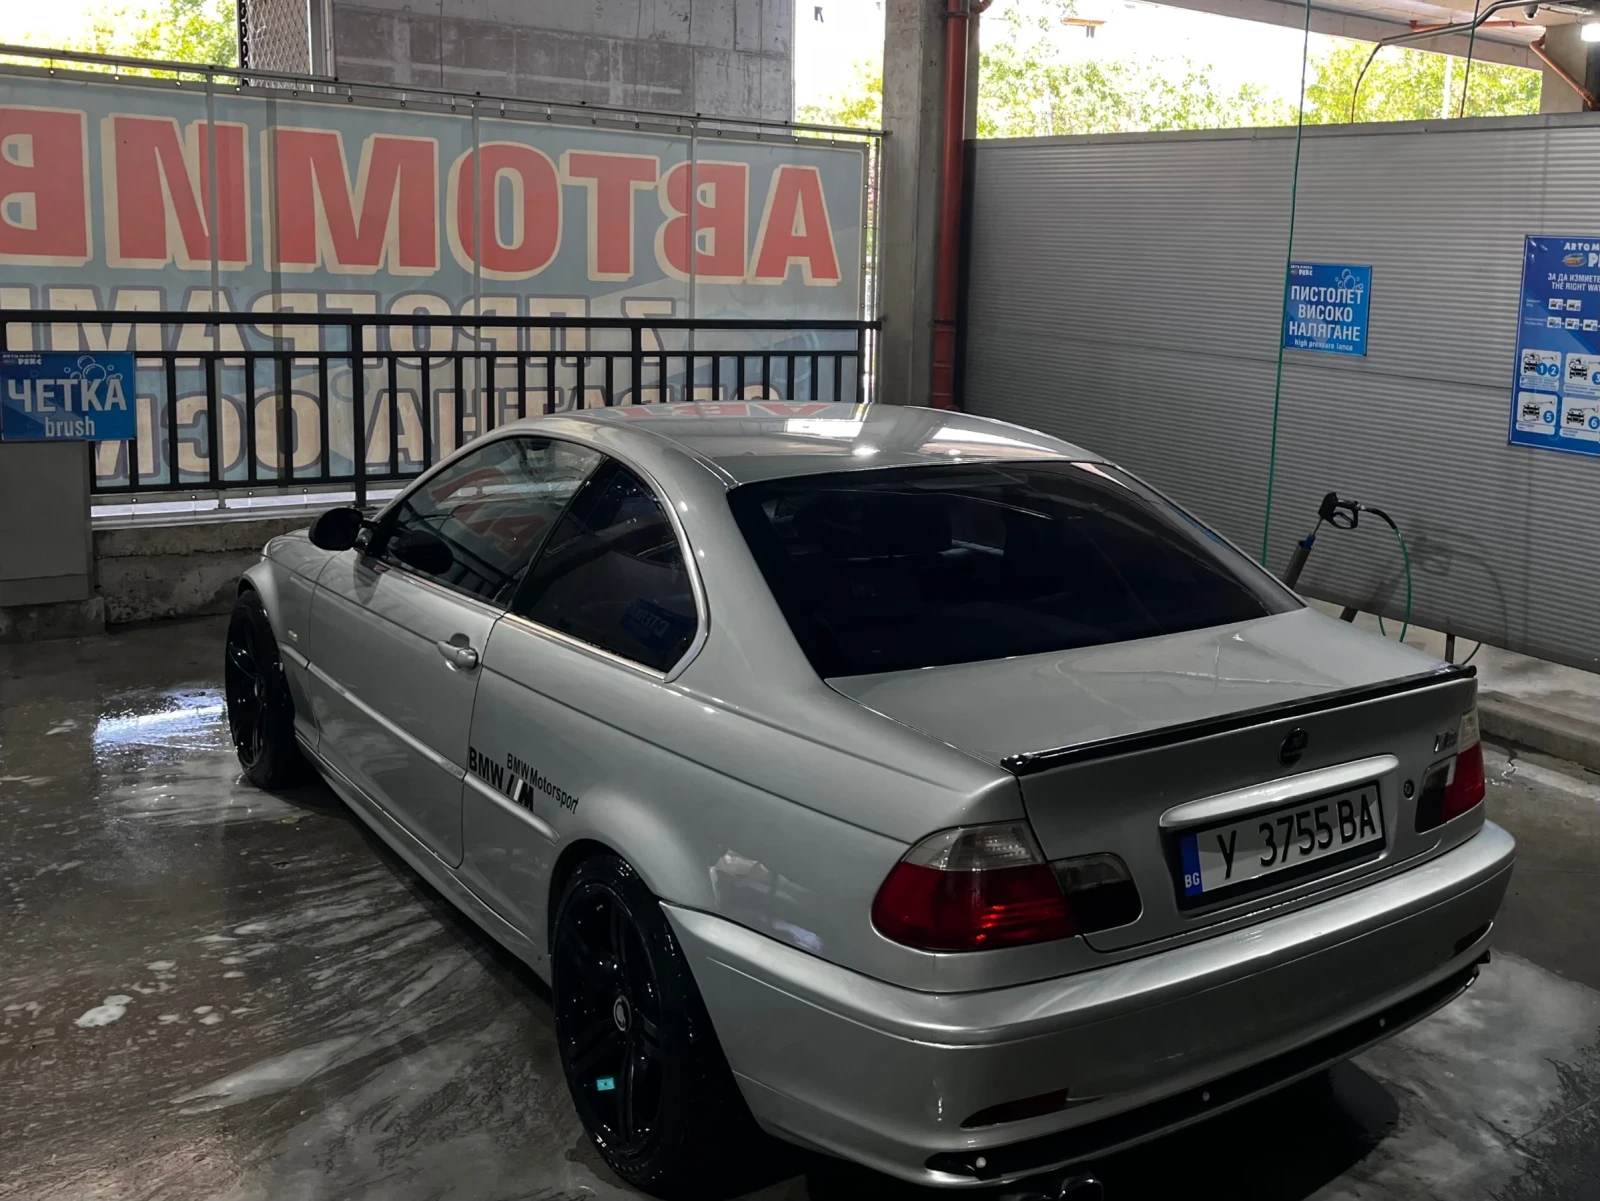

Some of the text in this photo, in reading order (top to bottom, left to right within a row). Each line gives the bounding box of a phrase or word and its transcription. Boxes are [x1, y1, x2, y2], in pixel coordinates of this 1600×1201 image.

[1552, 282, 1564, 290] THE
[1566, 283, 1586, 291] RIGHT
[1558, 273, 1568, 282] ДА
[1290, 285, 1364, 305] ПИСТОЛЕТ
[1298, 304, 1353, 322] ВИСОКО
[1289, 321, 1361, 341] НАЛЯГАНЕ
[1309, 341, 1335, 350] pressure
[1336, 343, 1353, 351] lance
[8, 378, 127, 412] ЧЕТКА
[45, 415, 95, 437] brush
[469, 746, 504, 790] BMW
[507, 753, 579, 814] BMW Motorsport
[1258, 805, 1333, 867] 3755
[1184, 872, 1200, 888] BG
